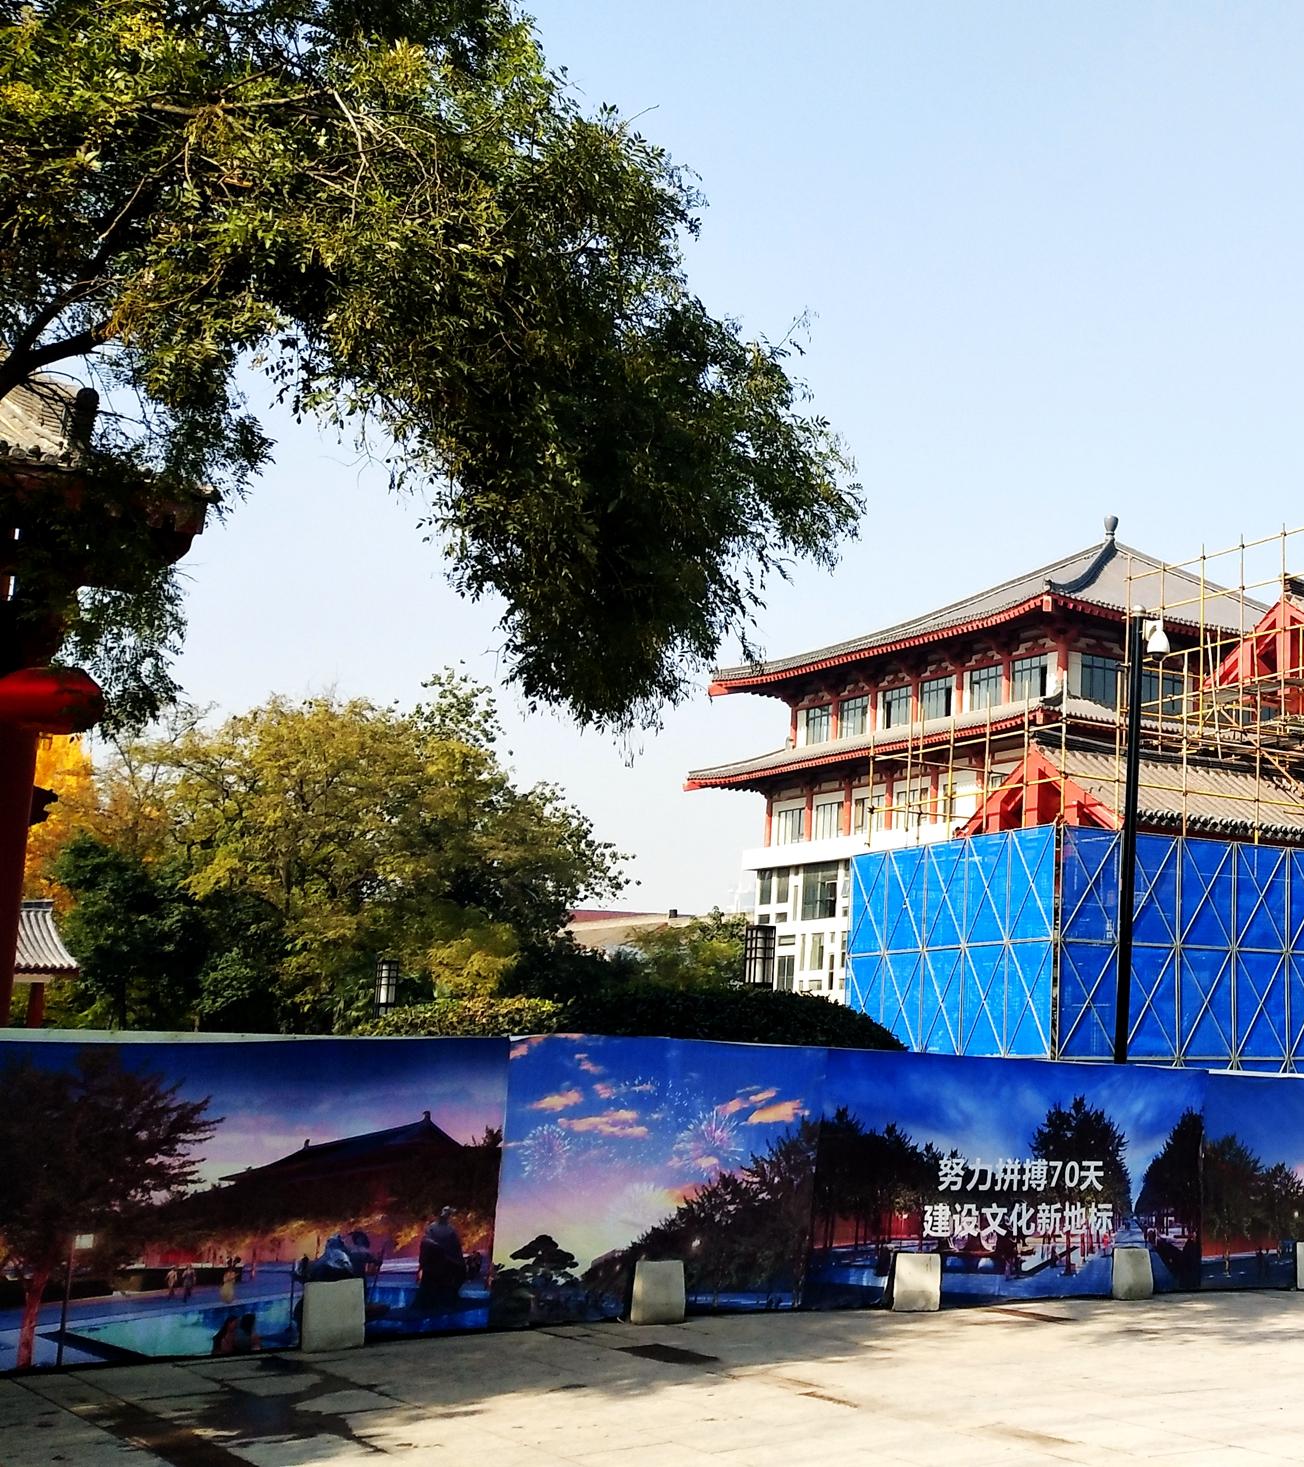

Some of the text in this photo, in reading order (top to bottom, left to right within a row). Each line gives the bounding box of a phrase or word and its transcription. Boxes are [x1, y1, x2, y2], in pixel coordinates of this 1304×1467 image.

[938, 1158, 1104, 1191] 努力拼搏70天
[923, 1202, 1114, 1238] 建设文化新地标
